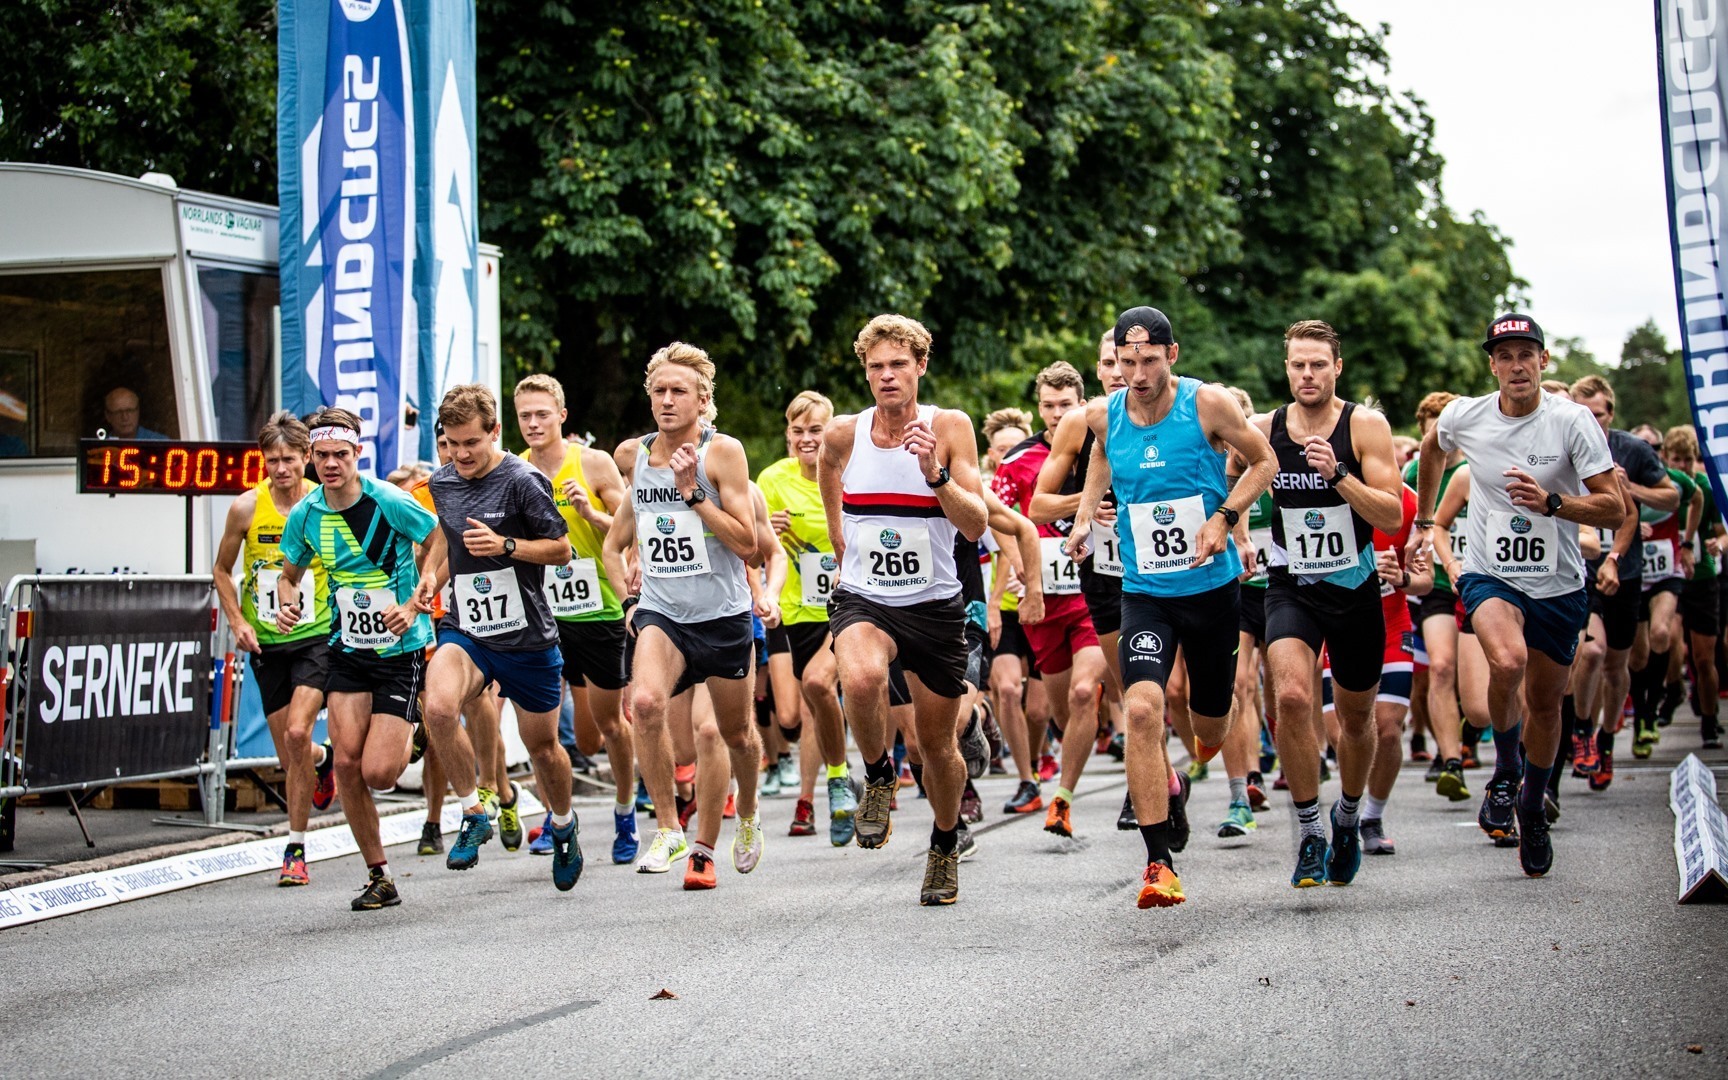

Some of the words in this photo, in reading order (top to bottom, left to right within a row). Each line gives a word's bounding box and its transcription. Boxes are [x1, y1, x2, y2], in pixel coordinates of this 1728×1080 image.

[182, 207, 223, 225] NORRLANDS
[235, 215, 262, 232] VAGNAR
[1139, 461, 1166, 469] ICEBUG
[1273, 472, 1328, 490] SERNE
[637, 487, 685, 504] RUNNE
[648, 536, 695, 563] 265
[1104, 540, 1121, 562] 1
[1152, 527, 1188, 557] 83
[1296, 532, 1344, 558] 170
[1496, 536, 1545, 562] 306
[657, 562, 703, 574] BRUNBERGS
[869, 551, 920, 576] 266
[1049, 560, 1081, 581] 14
[1155, 556, 1197, 569] BRUNBER
[1304, 556, 1351, 570] BRUNBERGS
[1502, 565, 1550, 573] BRUNBERGS
[548, 579, 590, 603] 149
[817, 573, 835, 595] 9
[878, 577, 927, 587] BRUNBERGS
[466, 594, 508, 623] 317
[557, 601, 597, 612] BRUNBERGS
[347, 611, 388, 635] 288
[476, 619, 520, 633] BRUNBERGS
[354, 636, 395, 645] BRUNBERGS
[1129, 655, 1162, 664] ICEBUG
[197, 851, 258, 876] BRUNBERGS
[121, 865, 183, 892] BRUNBERGS
[39, 880, 107, 908] BRUNBERGS
